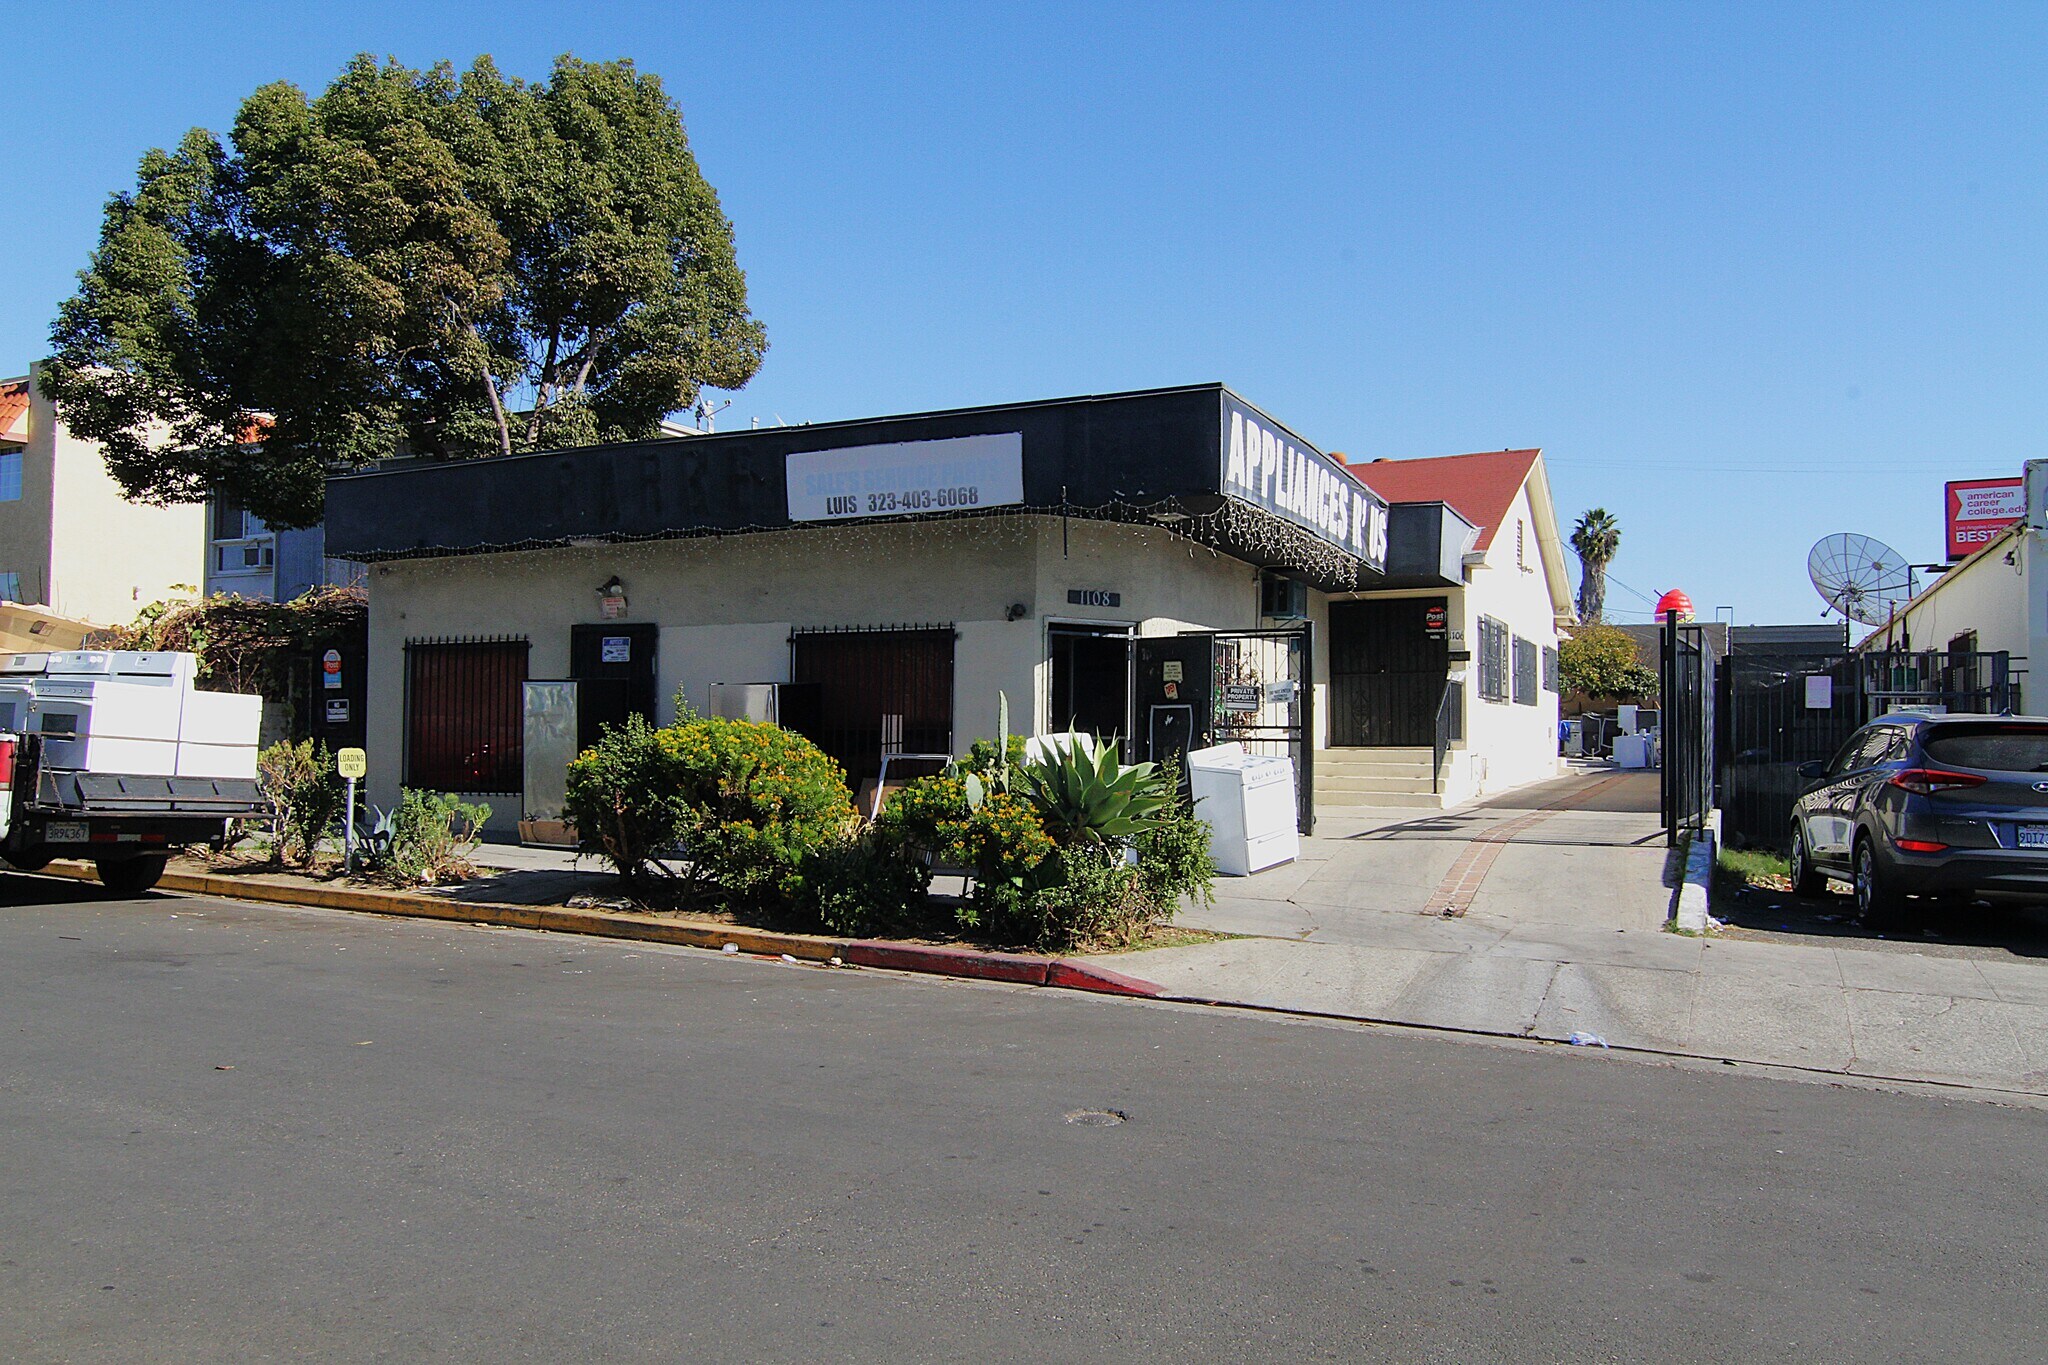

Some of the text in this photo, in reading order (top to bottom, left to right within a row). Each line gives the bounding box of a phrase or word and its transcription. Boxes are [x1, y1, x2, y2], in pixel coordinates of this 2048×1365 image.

[805, 471, 860, 497] SALE'S
[864, 464, 938, 492] SERVICE
[1227, 410, 1349, 541] APPLIANCES
[1369, 505, 1387, 564] US
[826, 486, 979, 515] LUIS 323-403-6068
[1967, 491, 2015, 500] american
[1956, 530, 1998, 543] BEST
[1080, 590, 1110, 606] 1108
[340, 754, 364, 763] LOADING
[345, 763, 359, 771] ONLY
[48, 828, 87, 839] 3R94367
